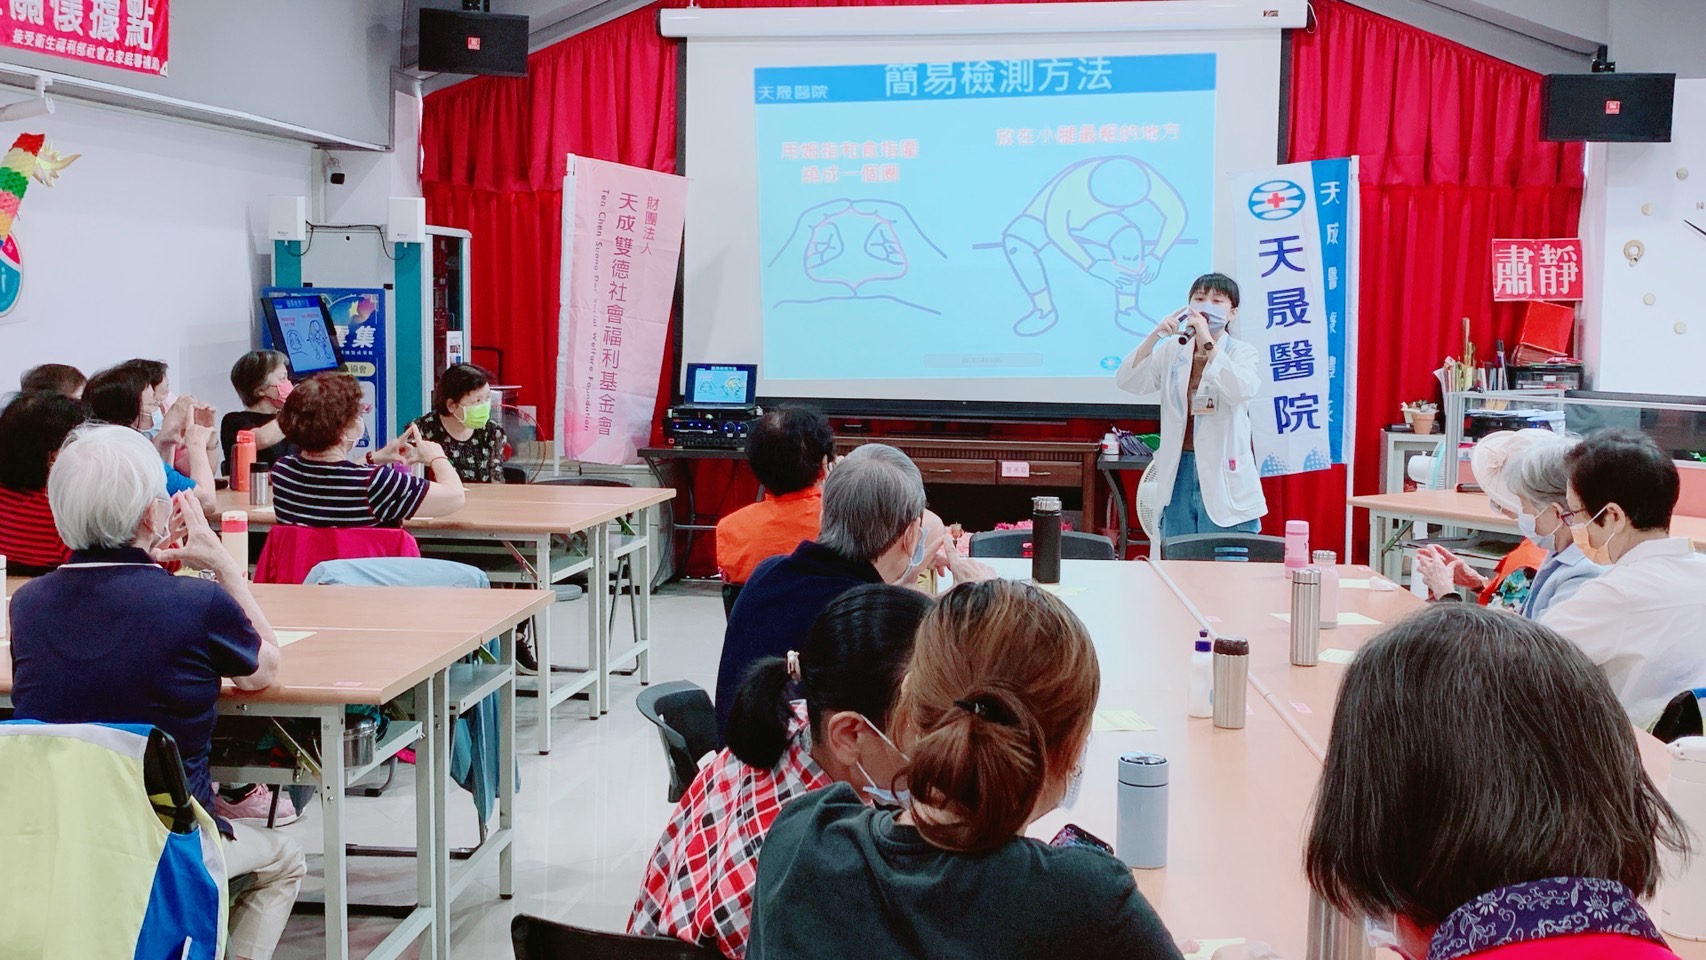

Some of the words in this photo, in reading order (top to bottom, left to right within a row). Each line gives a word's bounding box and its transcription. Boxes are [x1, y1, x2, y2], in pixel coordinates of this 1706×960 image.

[884, 57, 1114, 97] 簡易檢測方法
[596, 211, 607, 237] Chen
[600, 189, 610, 207] Ten
[640, 196, 661, 256] 財團法人
[1494, 243, 1579, 296] 肅靜
[597, 192, 639, 436] 天成雙德社會福利基金會
[1258, 235, 1321, 434] 天晟醫院
